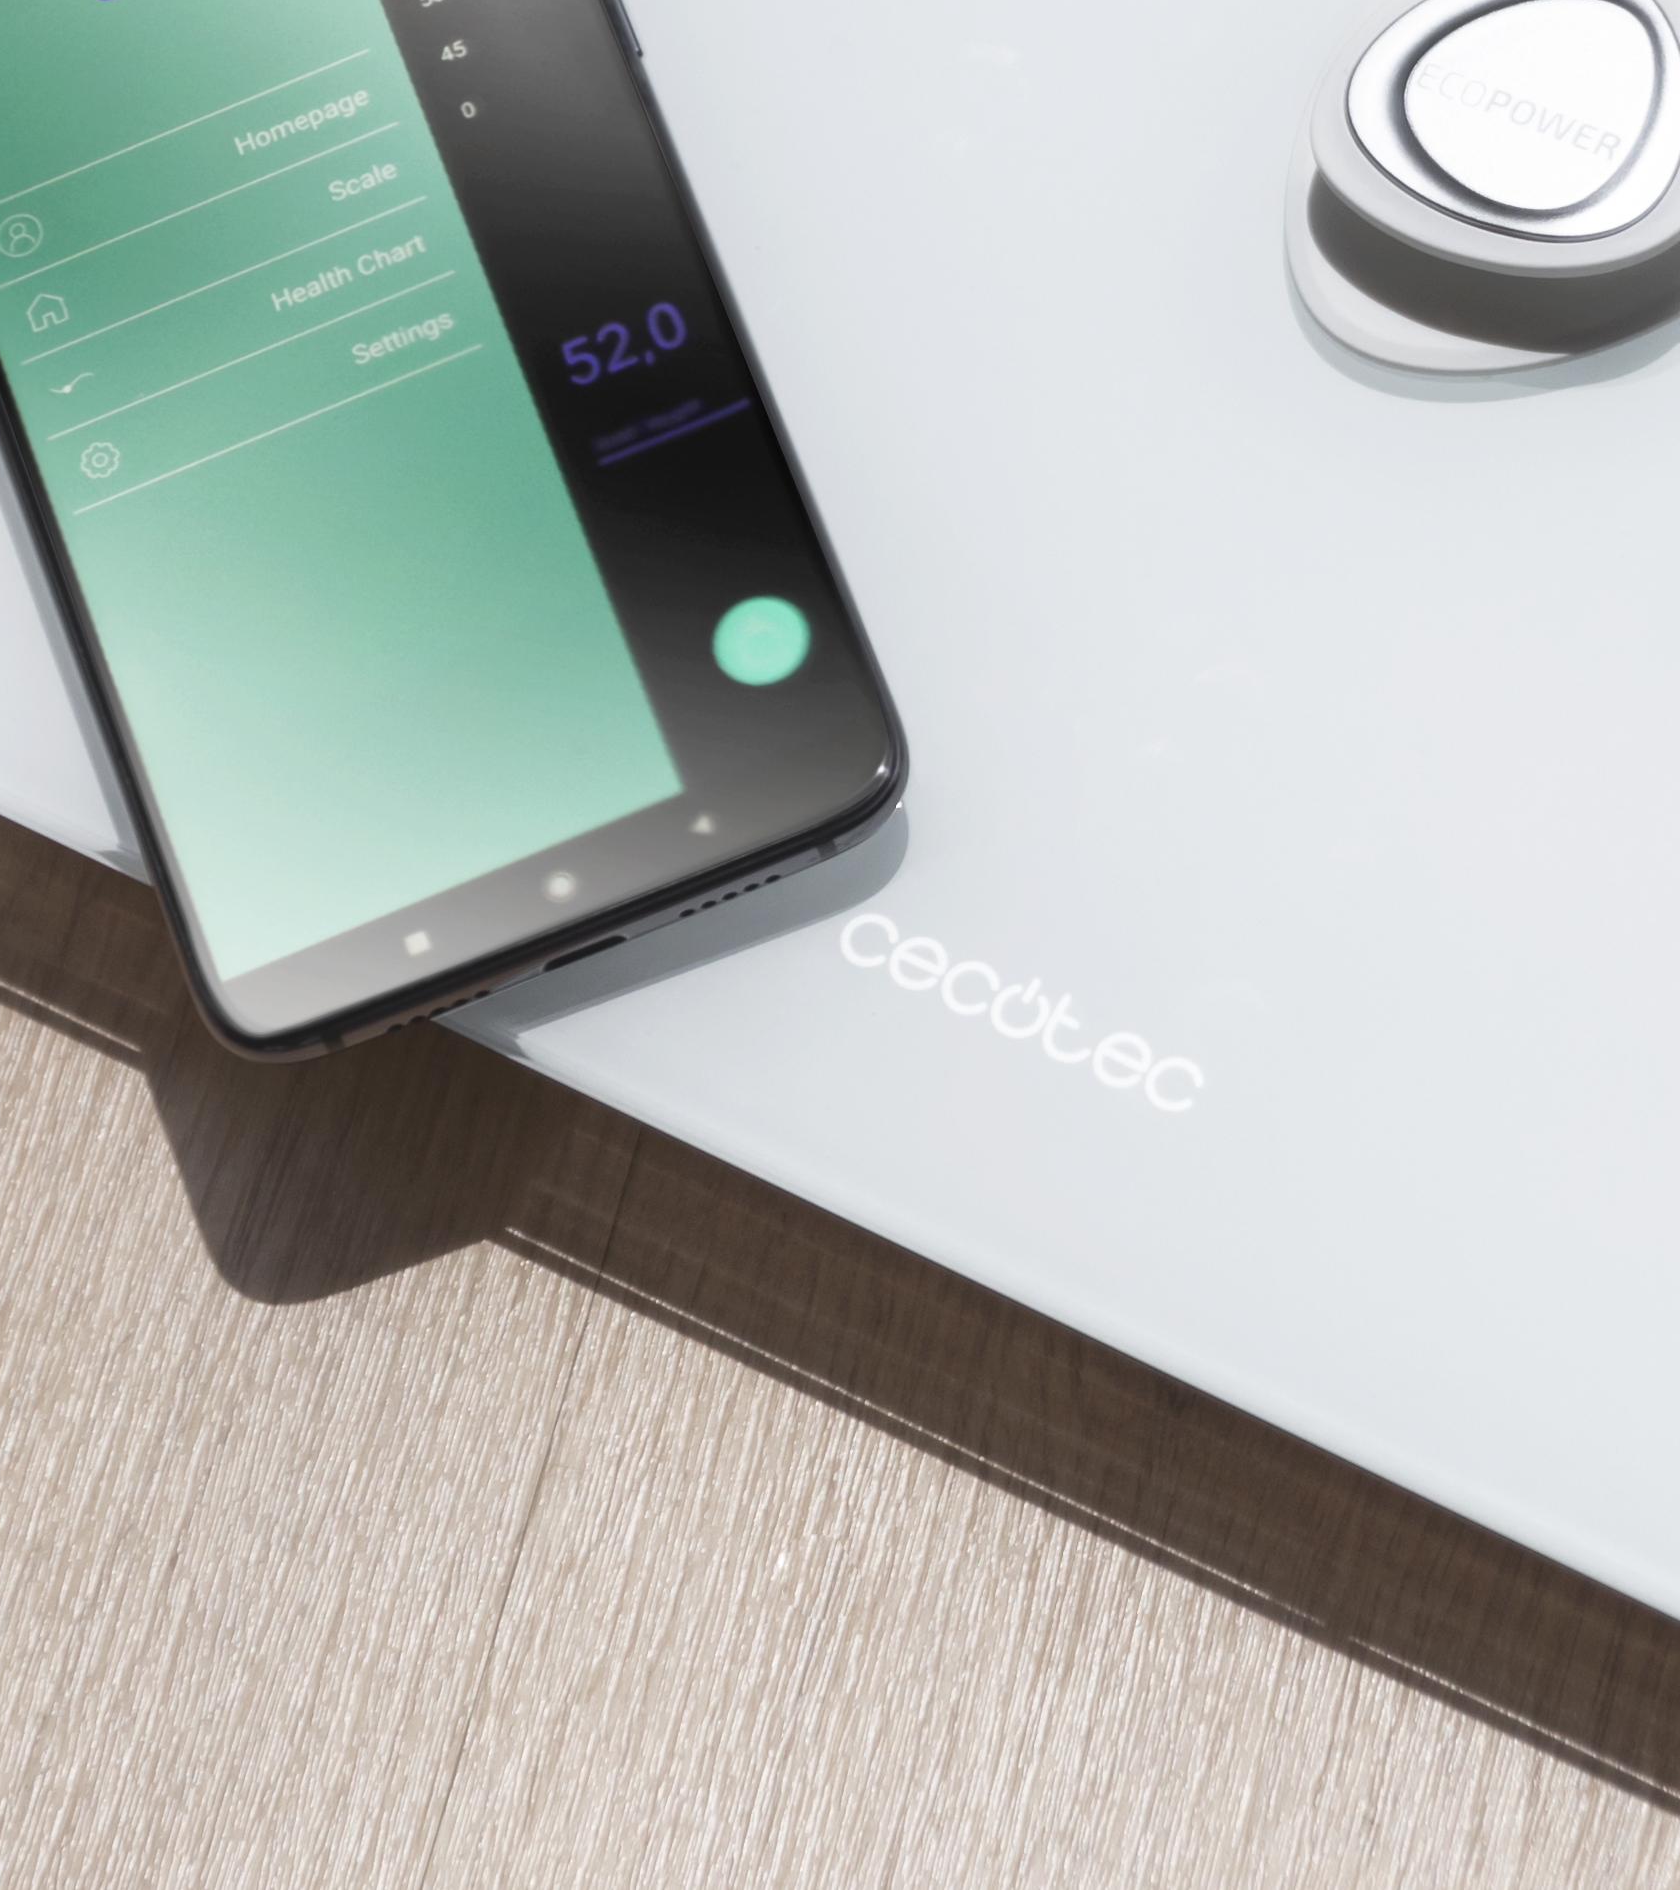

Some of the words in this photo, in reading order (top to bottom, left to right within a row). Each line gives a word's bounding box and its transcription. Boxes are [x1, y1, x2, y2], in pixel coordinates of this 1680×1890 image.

[439, 39, 469, 63] 45
[234, 88, 370, 155] Homepage
[1416, 62, 1622, 161] ECOPOWER
[328, 159, 398, 203] Scale
[270, 263, 353, 312] Health
[355, 233, 428, 281] Chart
[351, 308, 455, 366] Settings
[840, 913, 1204, 1112] cecotec
